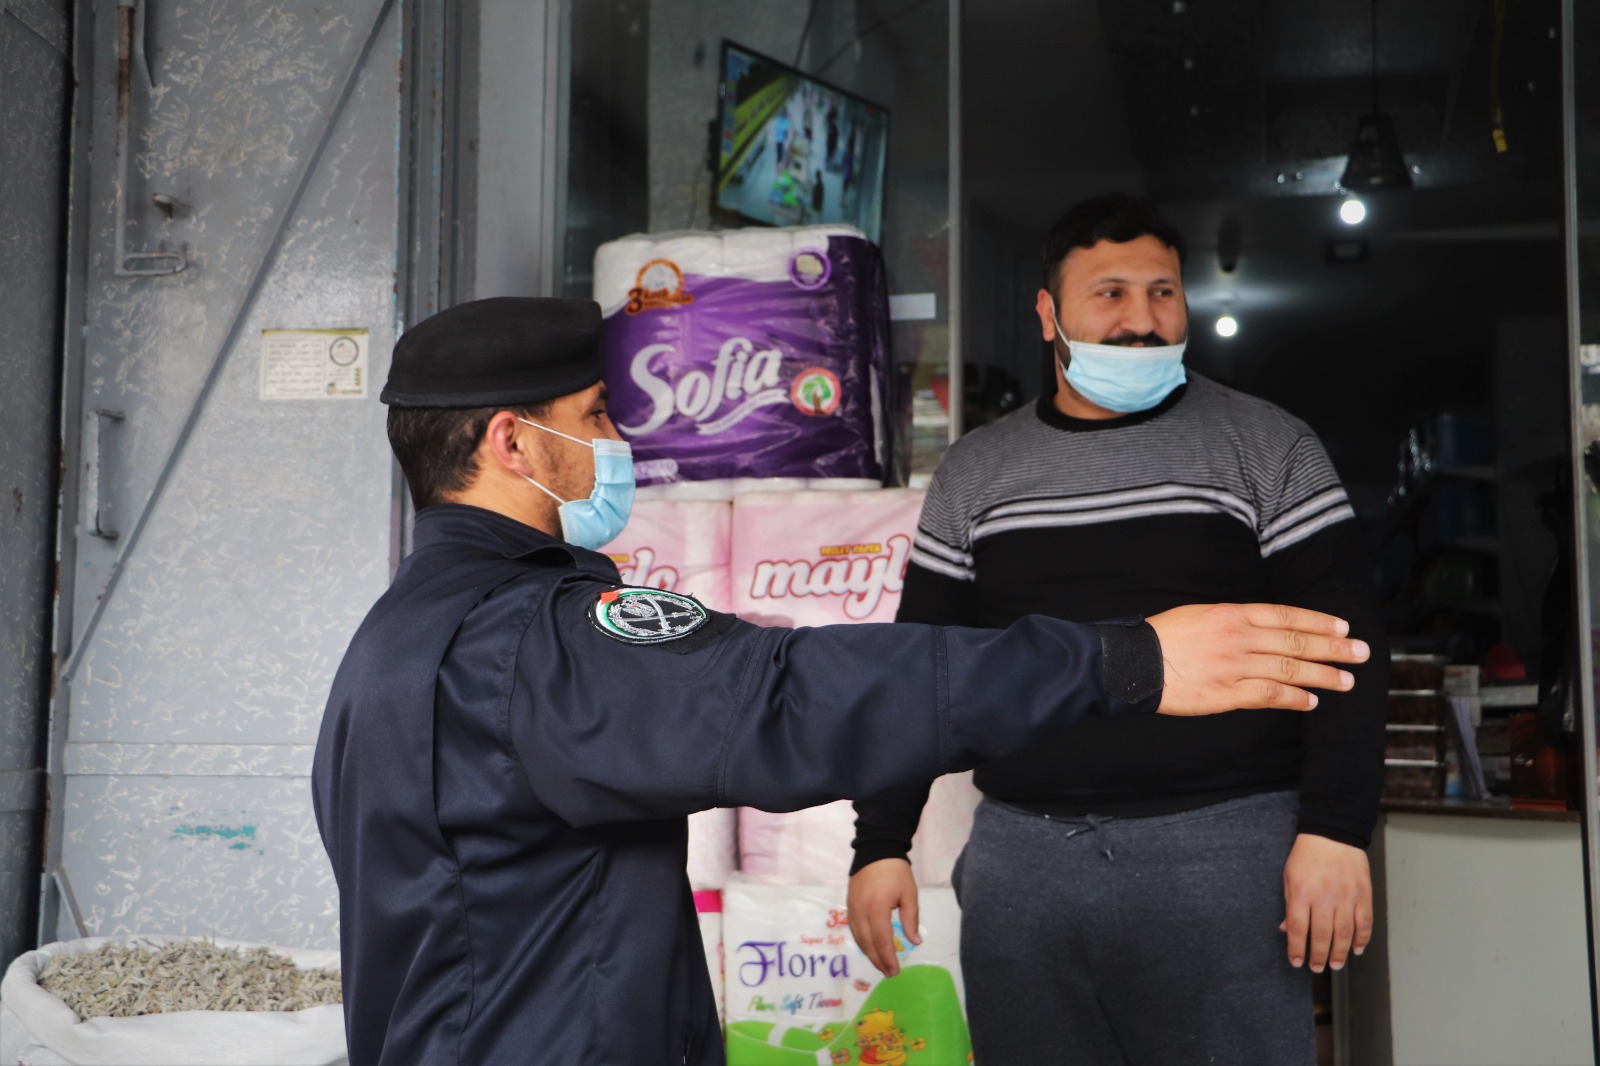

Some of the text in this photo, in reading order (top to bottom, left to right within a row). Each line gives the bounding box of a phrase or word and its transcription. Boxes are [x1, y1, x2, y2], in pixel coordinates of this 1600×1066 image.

[618, 337, 783, 437] Sofia
[750, 533, 911, 619] mayl
[736, 941, 849, 987] Flora
